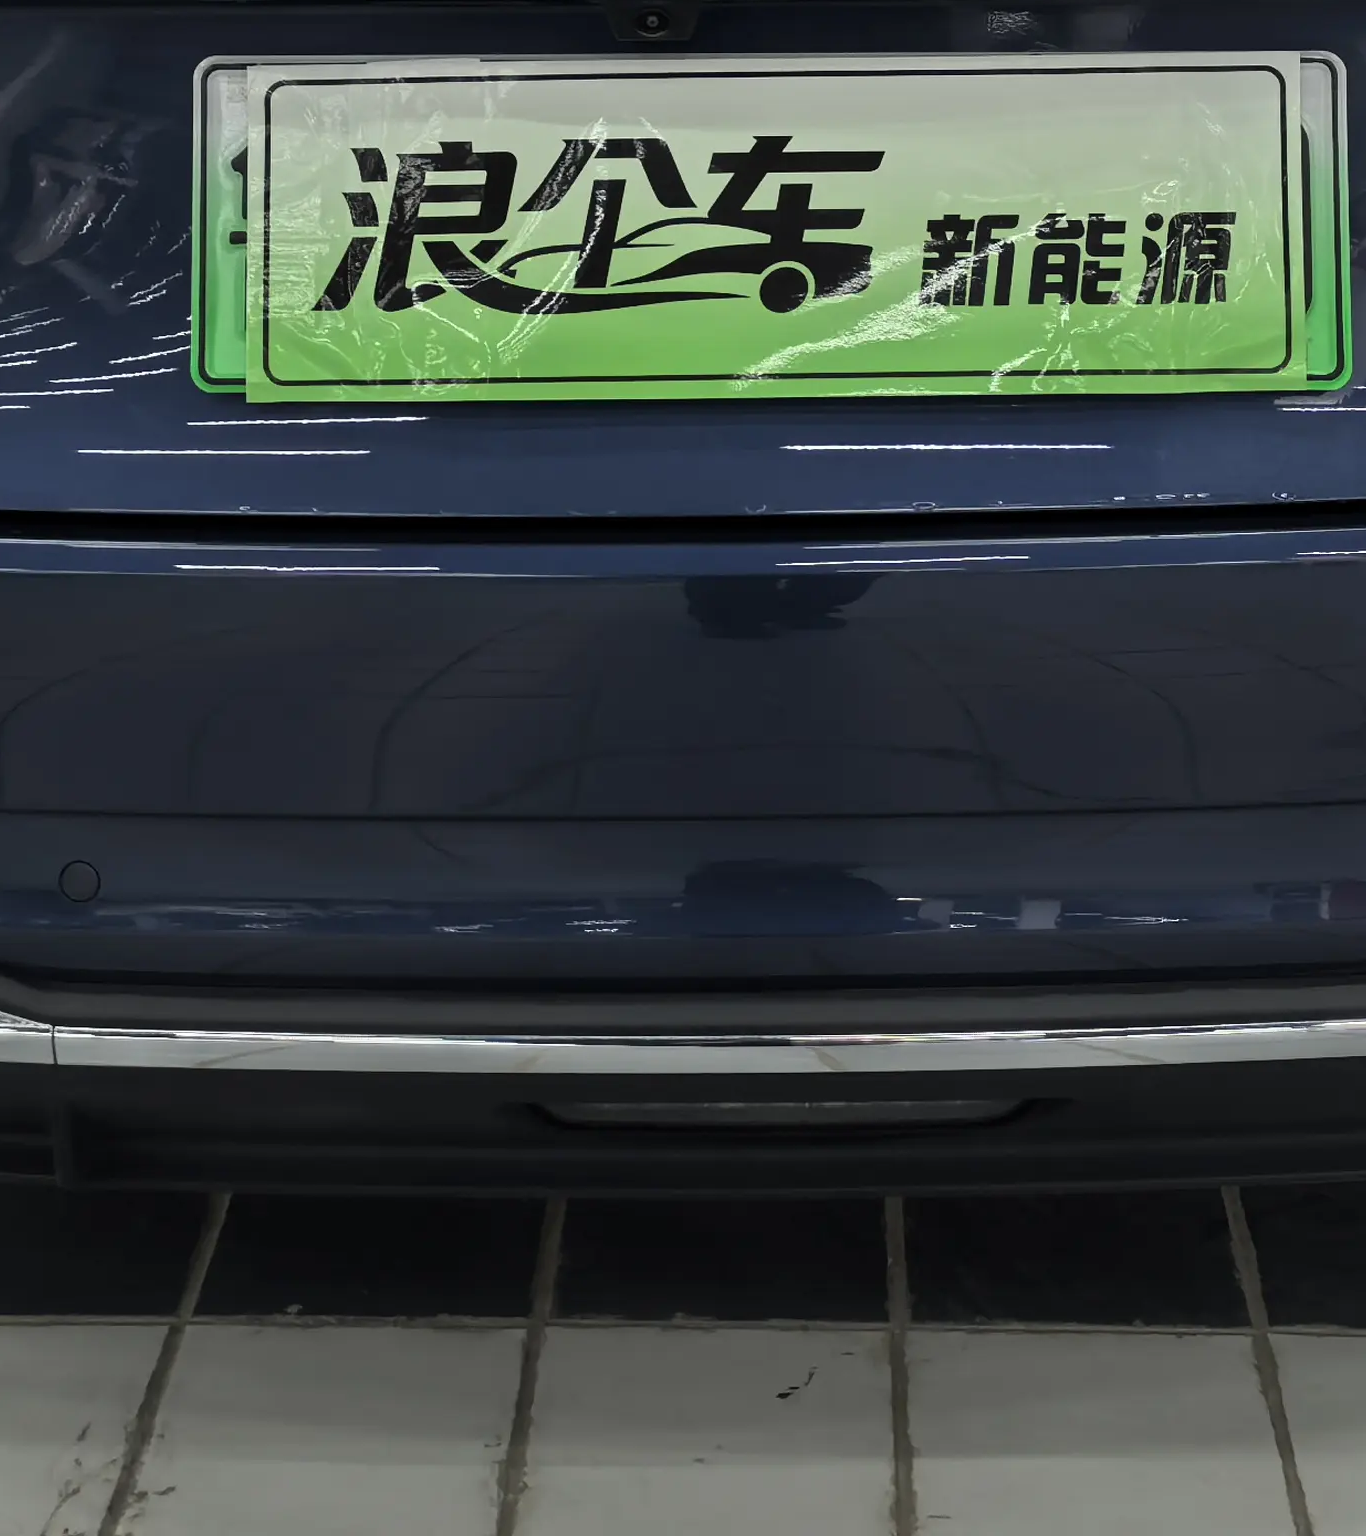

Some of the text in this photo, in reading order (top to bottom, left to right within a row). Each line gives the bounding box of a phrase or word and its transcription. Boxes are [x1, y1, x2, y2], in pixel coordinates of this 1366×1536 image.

[315, 135, 888, 315] 浪个车
[921, 210, 1238, 309] 新能源
